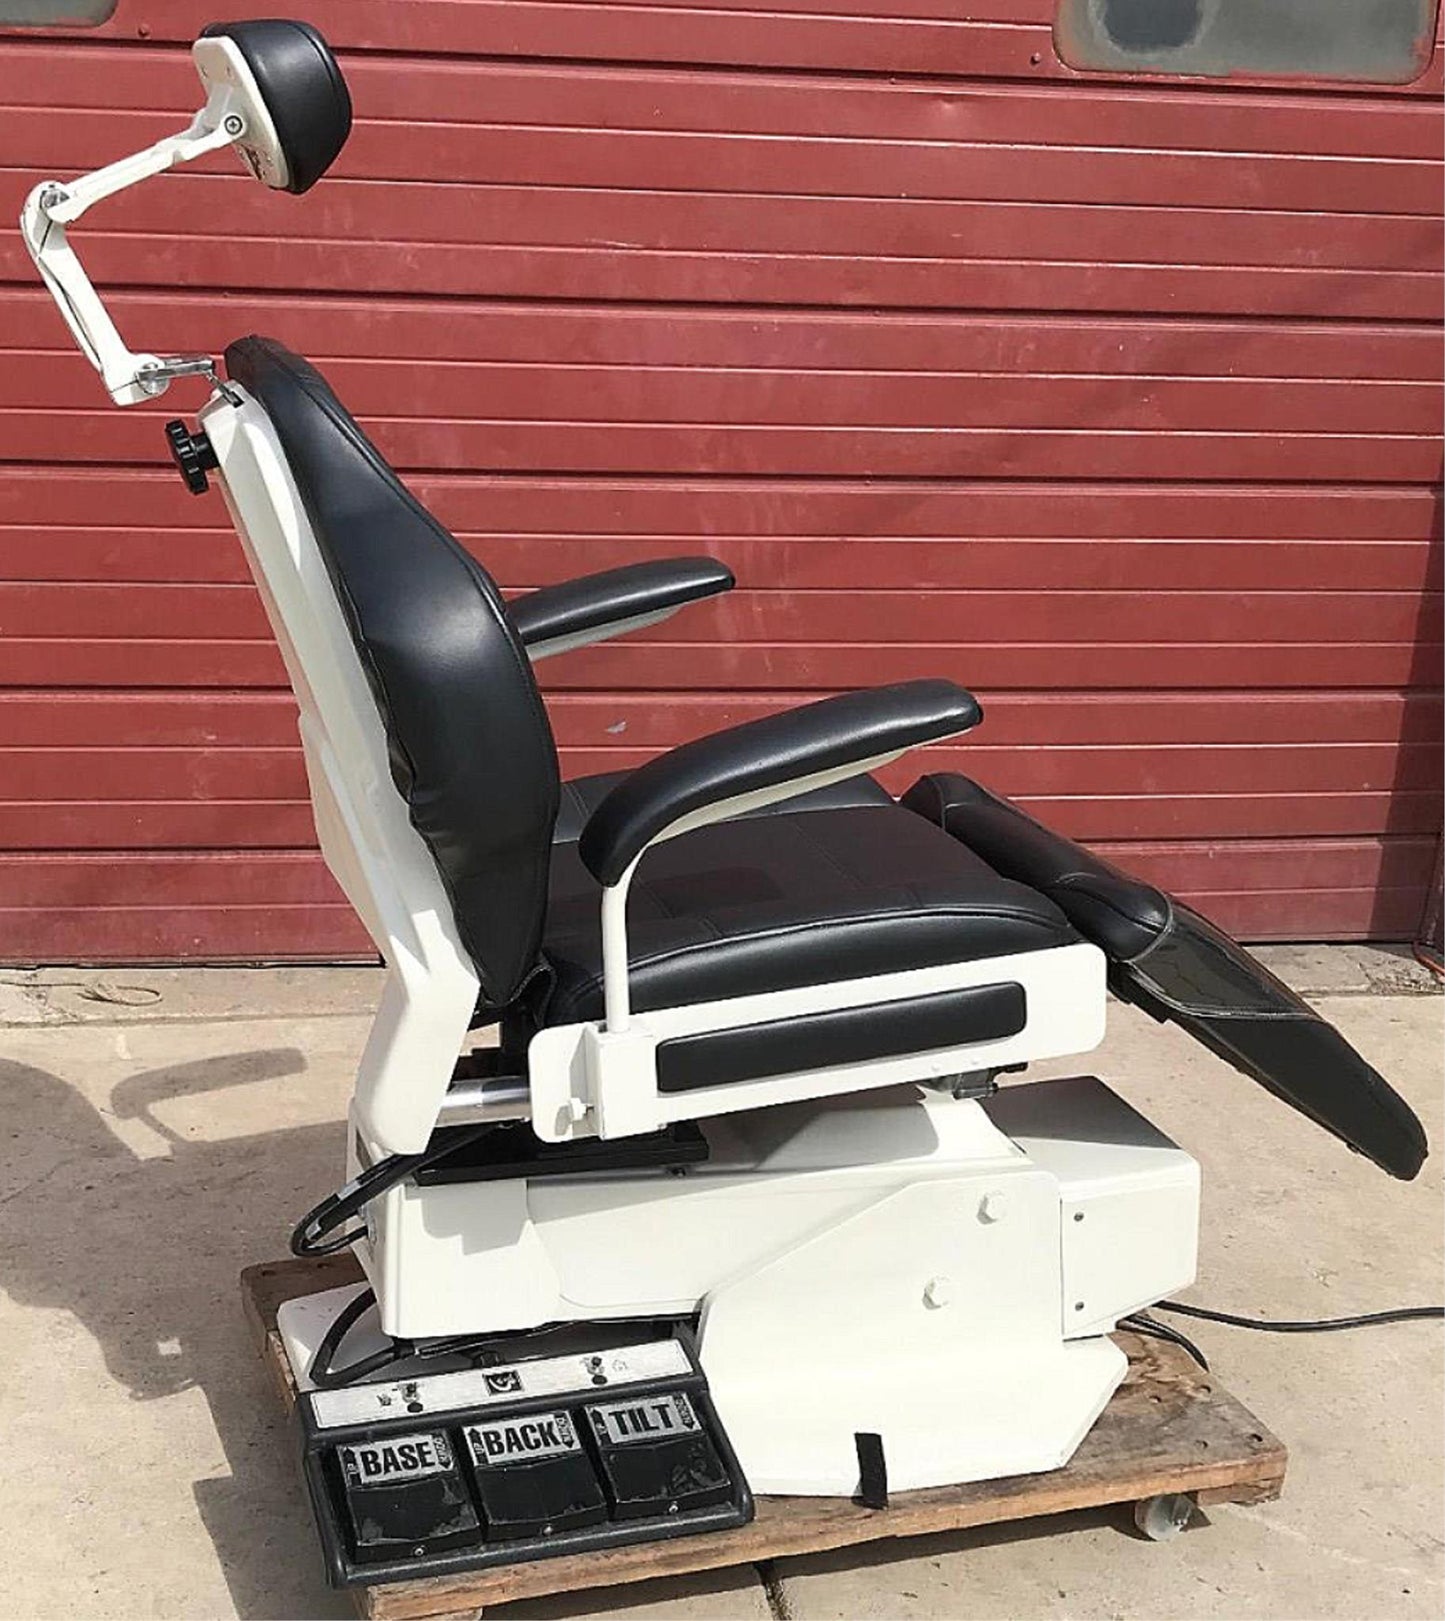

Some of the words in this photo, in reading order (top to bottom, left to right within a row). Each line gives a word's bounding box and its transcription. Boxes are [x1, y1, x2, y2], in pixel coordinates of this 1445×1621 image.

[608, 1404, 673, 1435] TILT
[482, 1421, 561, 1456] BACK
[360, 1442, 435, 1476] BASE
